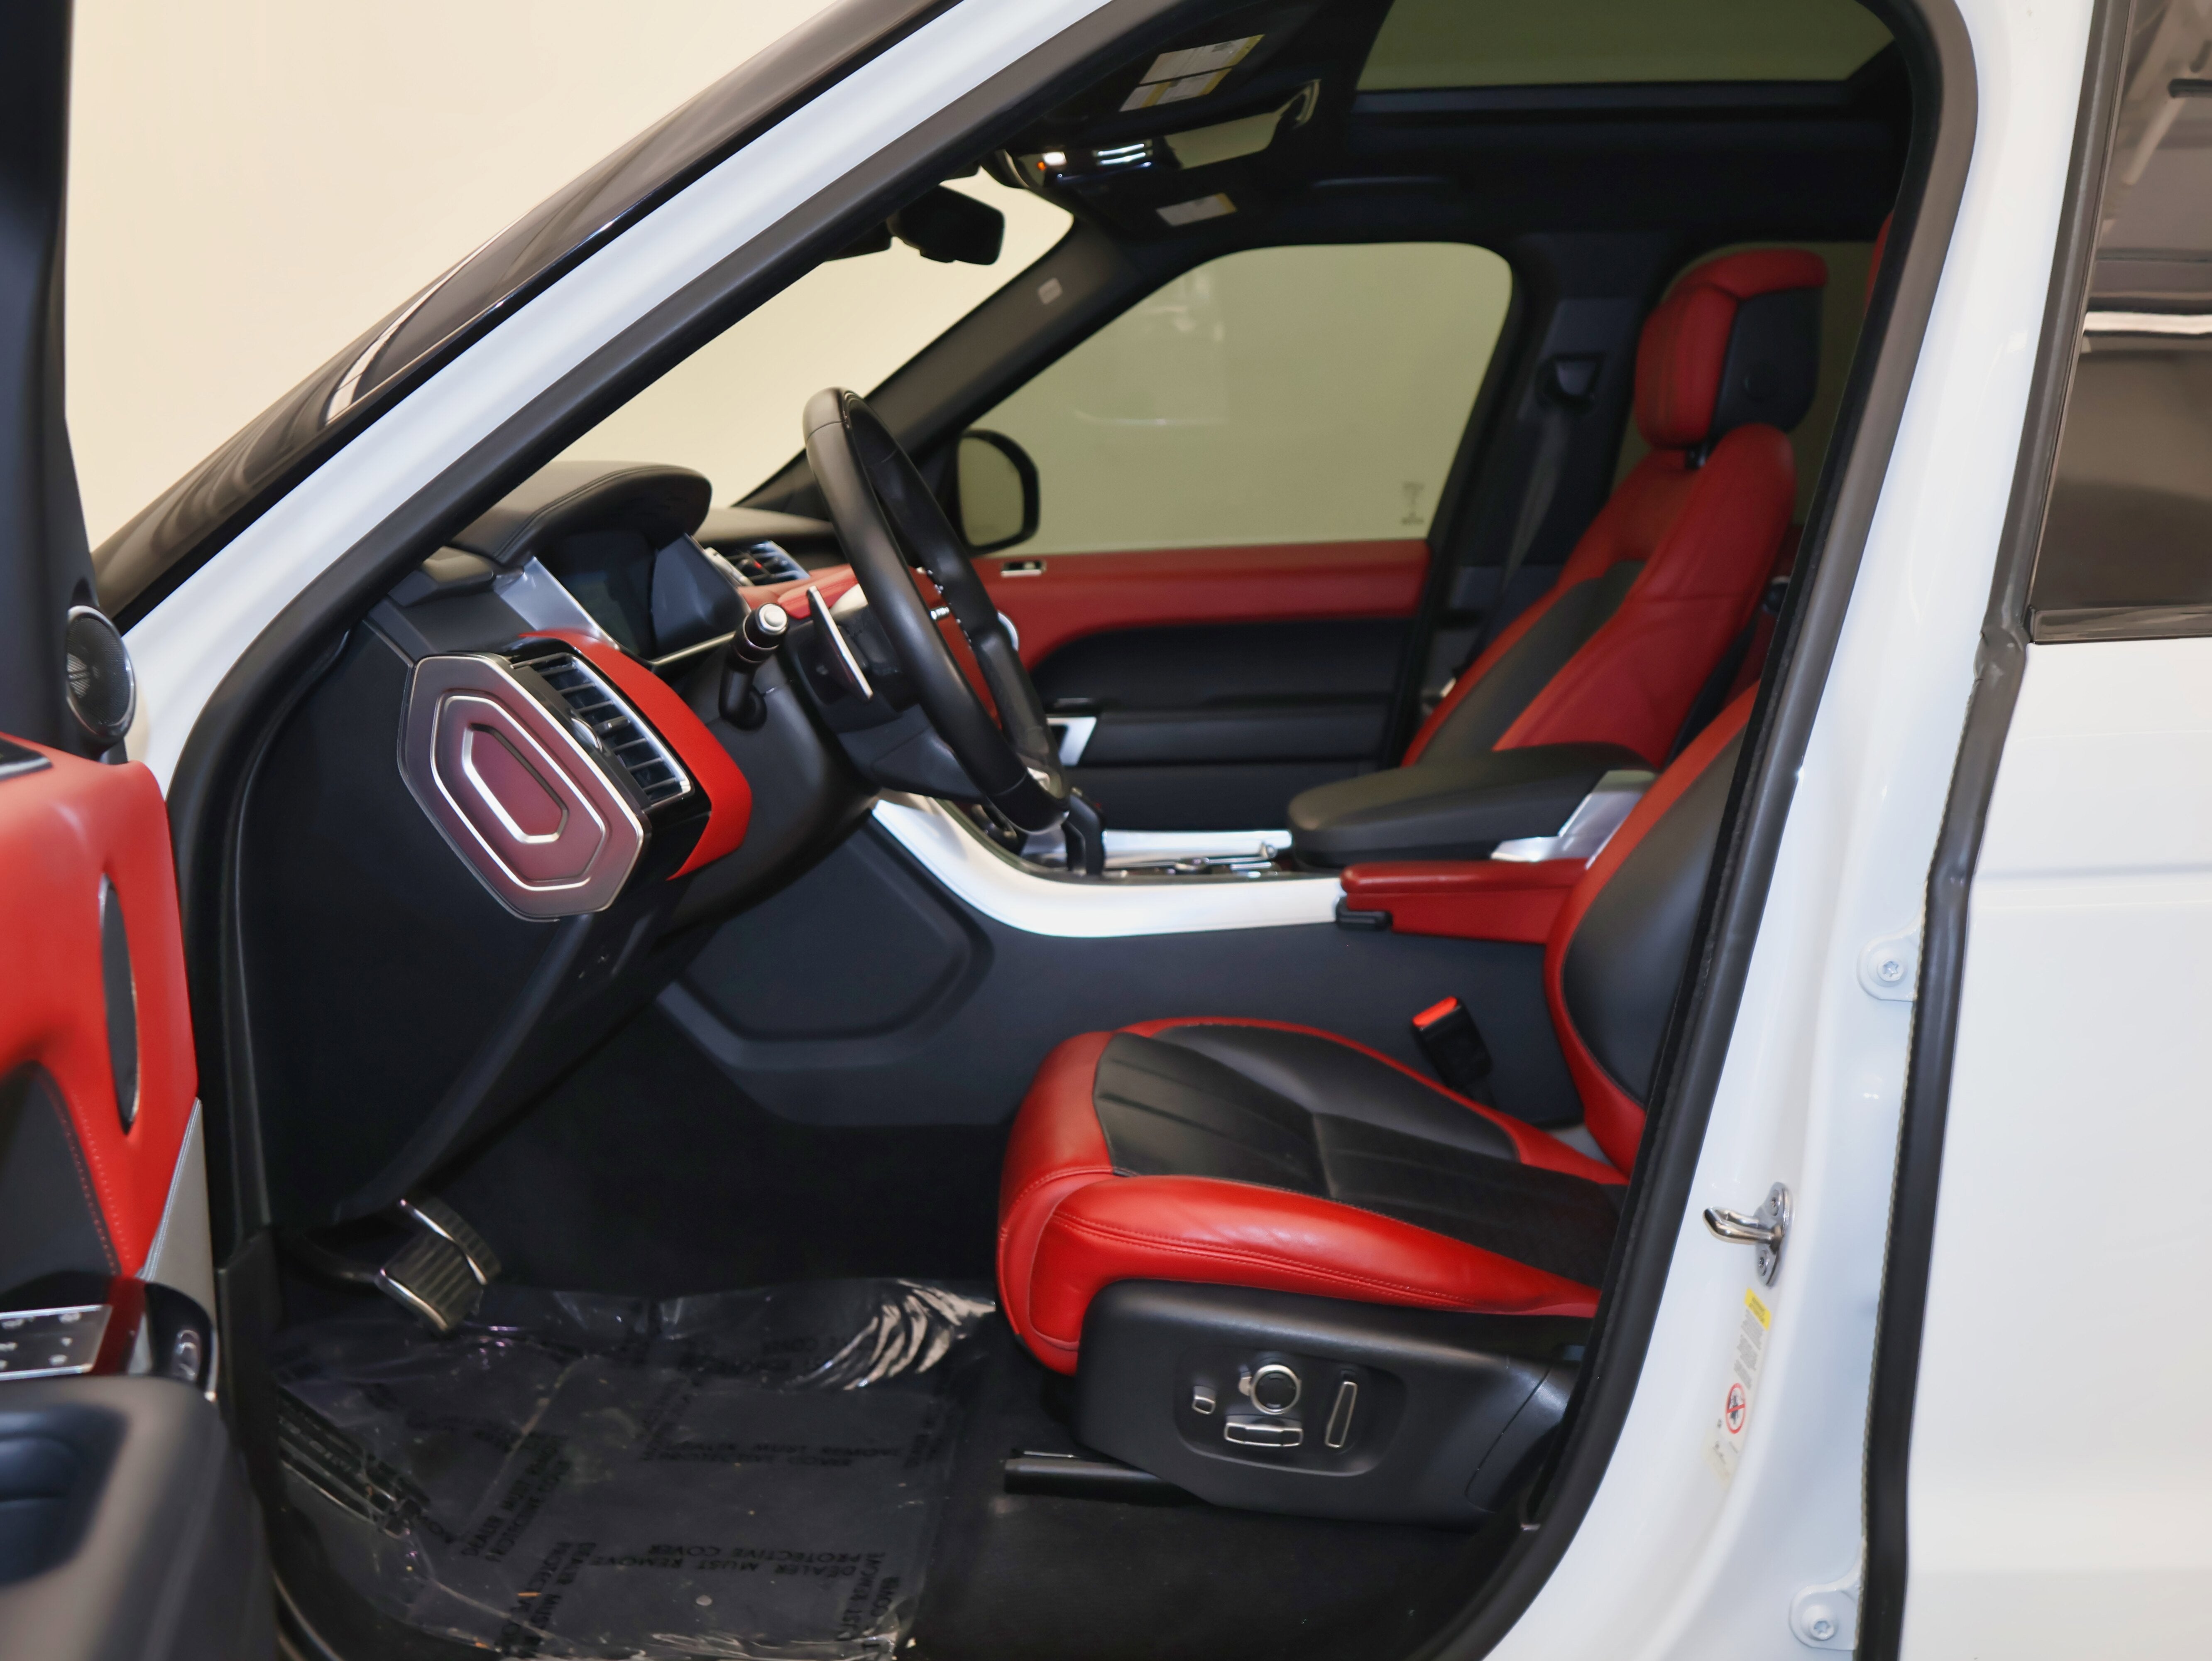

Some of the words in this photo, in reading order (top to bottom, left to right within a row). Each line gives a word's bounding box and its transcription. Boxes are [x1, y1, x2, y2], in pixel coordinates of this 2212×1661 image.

[460, 1515, 504, 1556] DEALER
[647, 1544, 722, 1557] COVER
[731, 1547, 861, 1563] PROTECTIVE
[554, 1541, 597, 1585] DEALER
[696, 1559, 759, 1571] MUST
[774, 1564, 856, 1578] DEALER
[510, 1541, 573, 1614] PROTECTVE
